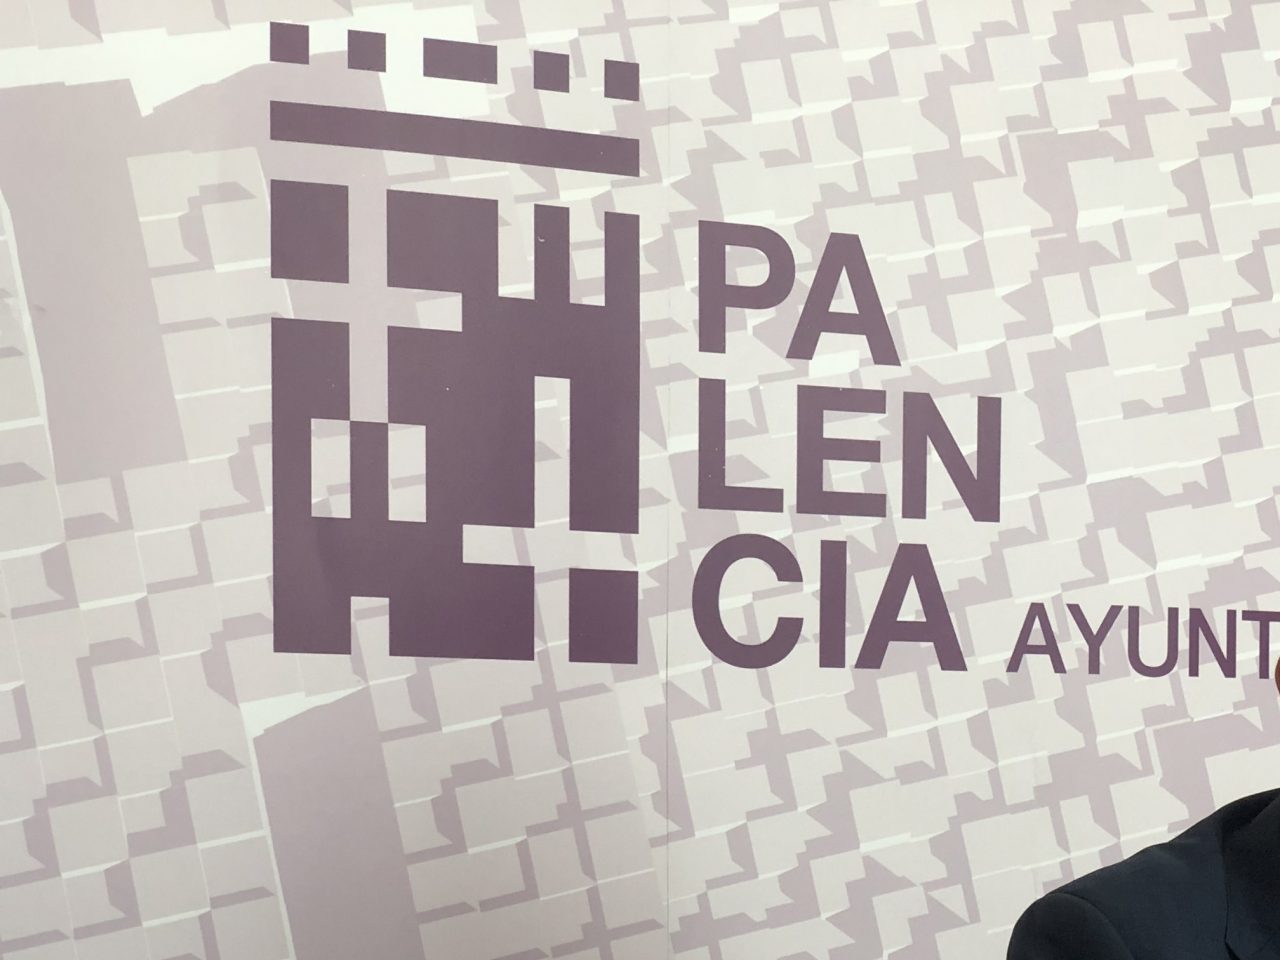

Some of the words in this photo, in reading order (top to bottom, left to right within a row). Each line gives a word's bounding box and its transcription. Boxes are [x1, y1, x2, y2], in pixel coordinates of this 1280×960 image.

[698, 219, 902, 367] PA
[697, 377, 1002, 523] LEN
[691, 533, 968, 672] CIA
